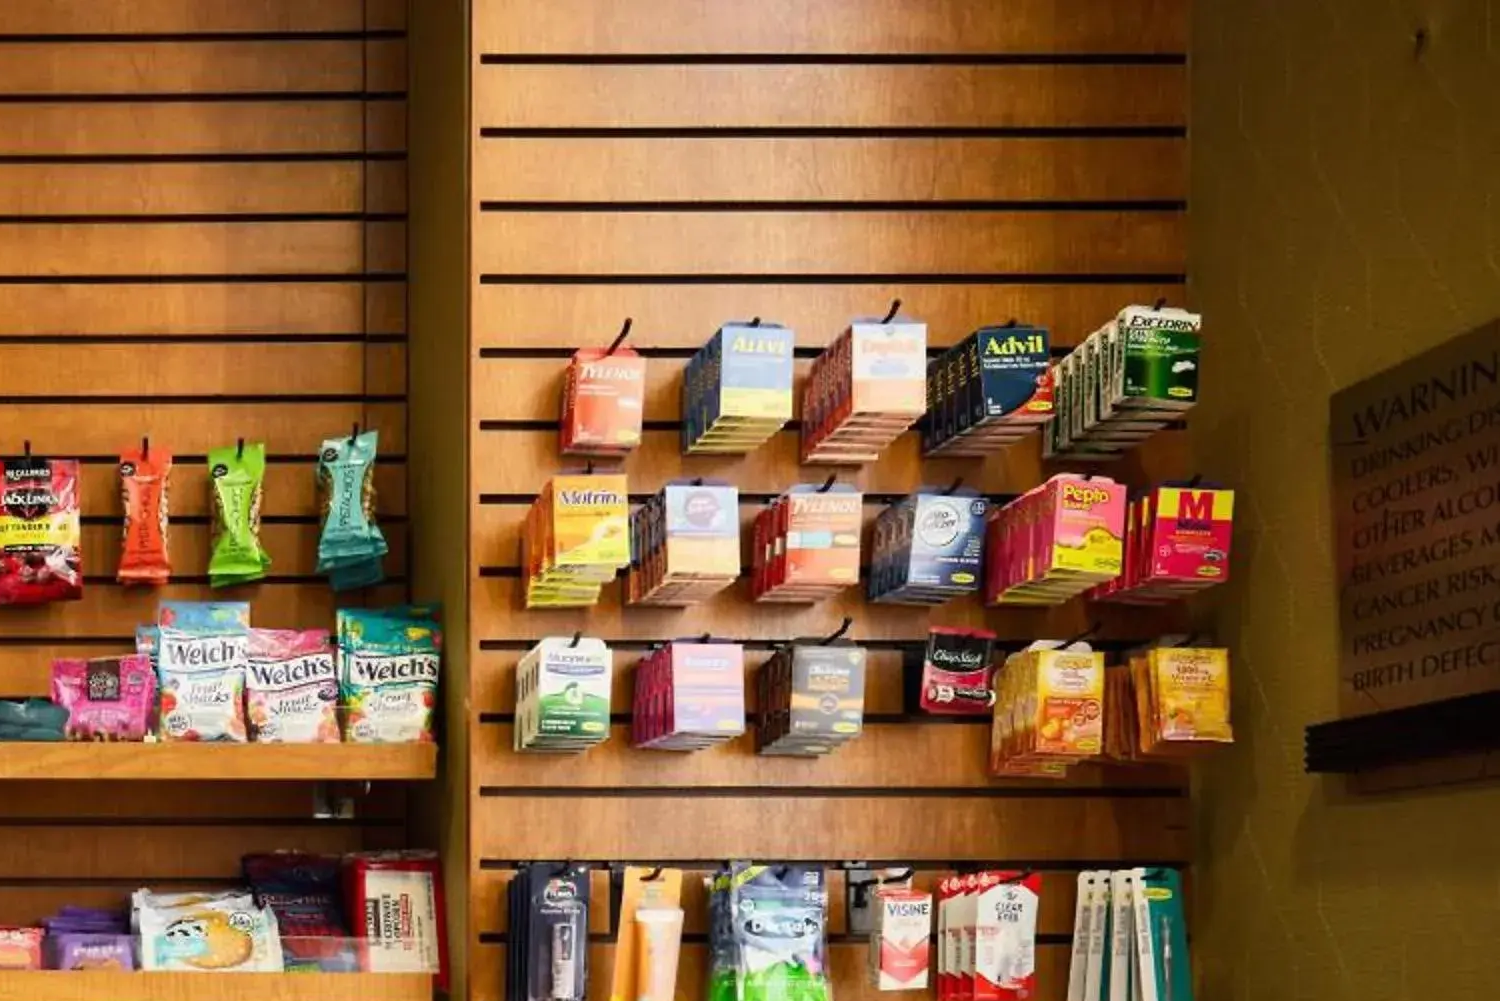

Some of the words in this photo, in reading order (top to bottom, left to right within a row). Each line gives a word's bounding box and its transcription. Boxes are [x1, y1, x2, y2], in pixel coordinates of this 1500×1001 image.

[1131, 315, 1199, 331] EXCEDRIN
[984, 335, 1044, 354] Advil
[1352, 418, 1463, 478] DRINKING
[1, 492, 29, 505] JACK
[561, 489, 618, 507] Motrin
[1063, 484, 1109, 503] Pepto
[1179, 491, 1214, 519] M
[1352, 508, 1426, 548] OTHER
[1433, 482, 1500, 525] ALCO
[1352, 530, 1474, 586] BEVERAGES
[1352, 578, 1440, 620] CANCER
[1352, 604, 1486, 656] PREGNANCY
[252, 656, 333, 685] Welch's
[357, 657, 437, 681] Welch's
[1353, 661, 1414, 690] BIRTH
[887, 903, 929, 917] VISINE
